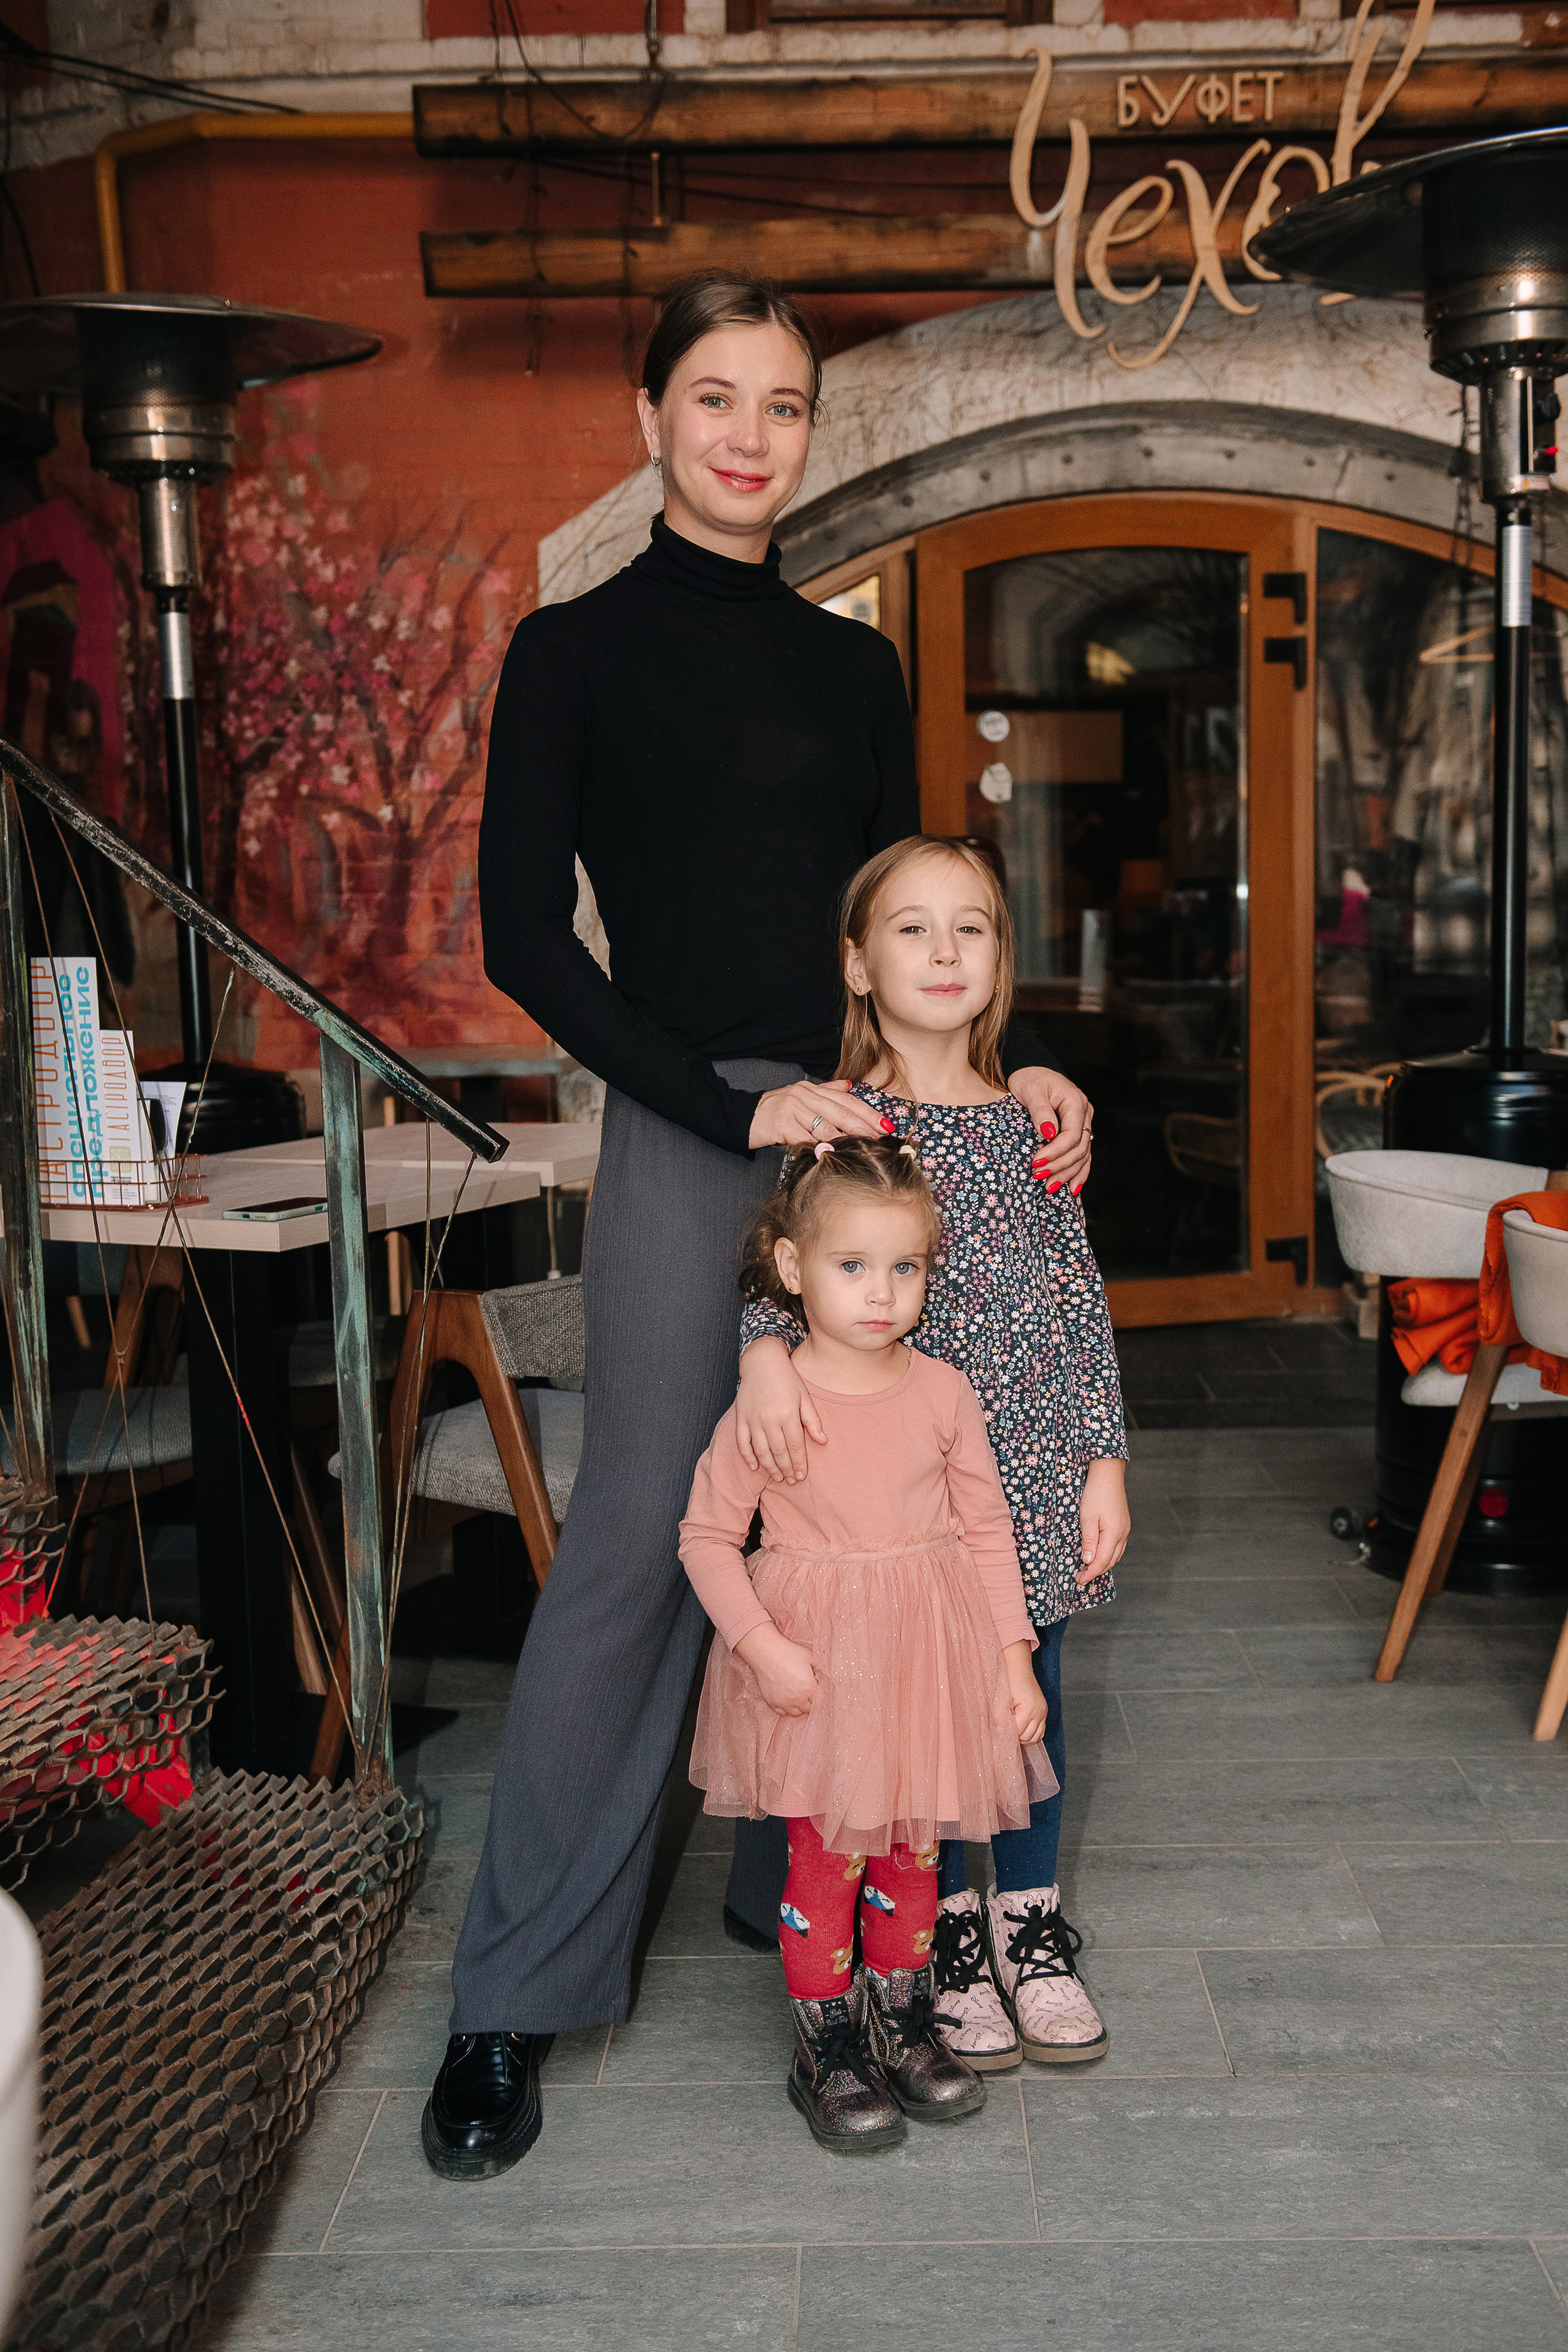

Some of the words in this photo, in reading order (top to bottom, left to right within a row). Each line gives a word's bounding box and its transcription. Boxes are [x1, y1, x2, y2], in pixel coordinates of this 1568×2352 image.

[1118, 71, 1285, 126] БУФЕТ
[1043, 1977, 1055, 1991] Disney
[946, 1999, 961, 2013] Disney
[970, 1994, 983, 2008] Disney
[958, 2007, 971, 2019] Disney
[971, 2032, 984, 2049] Disney
